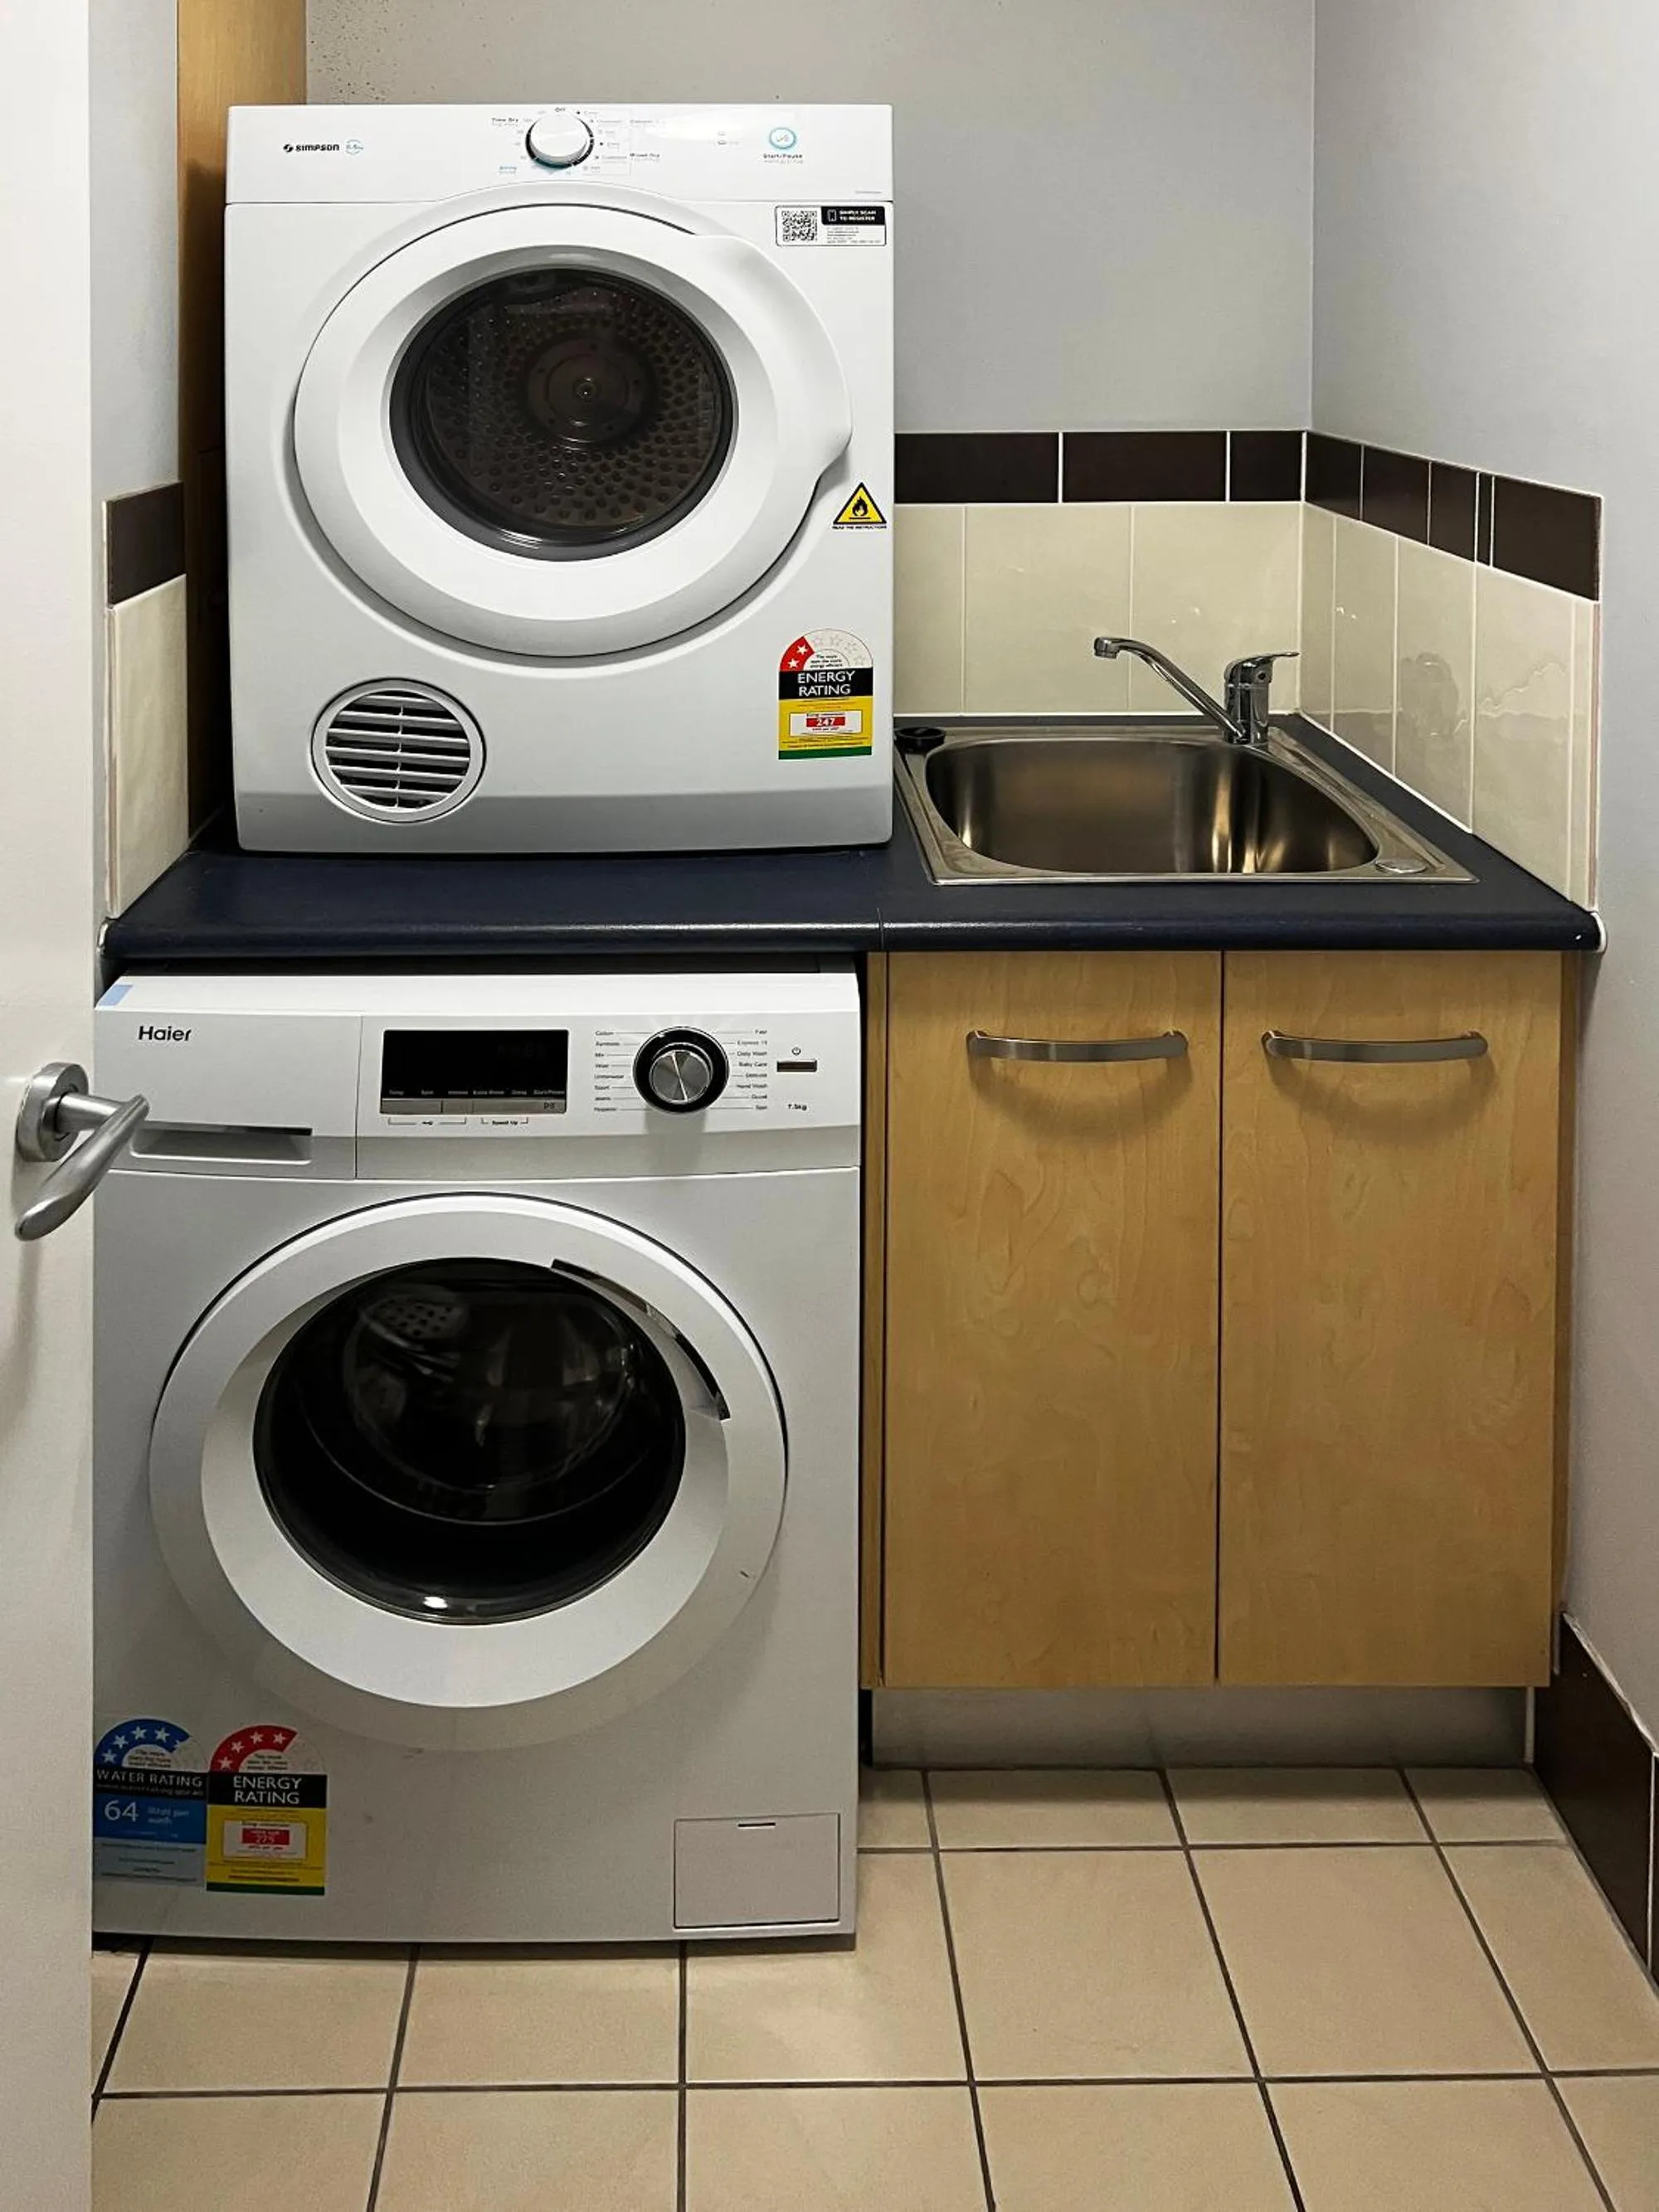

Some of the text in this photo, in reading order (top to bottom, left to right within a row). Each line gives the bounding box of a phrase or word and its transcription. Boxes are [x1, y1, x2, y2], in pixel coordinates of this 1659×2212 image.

[797, 670, 856, 683] ENERGY
[799, 683, 851, 697] RATING
[815, 717, 836, 727] 247
[138, 1025, 192, 1042] Haier
[96, 1768, 202, 1788] WATER RATING
[233, 1775, 303, 1790] ENERGY
[234, 1790, 300, 1805] RATING
[105, 1799, 139, 1823] 64
